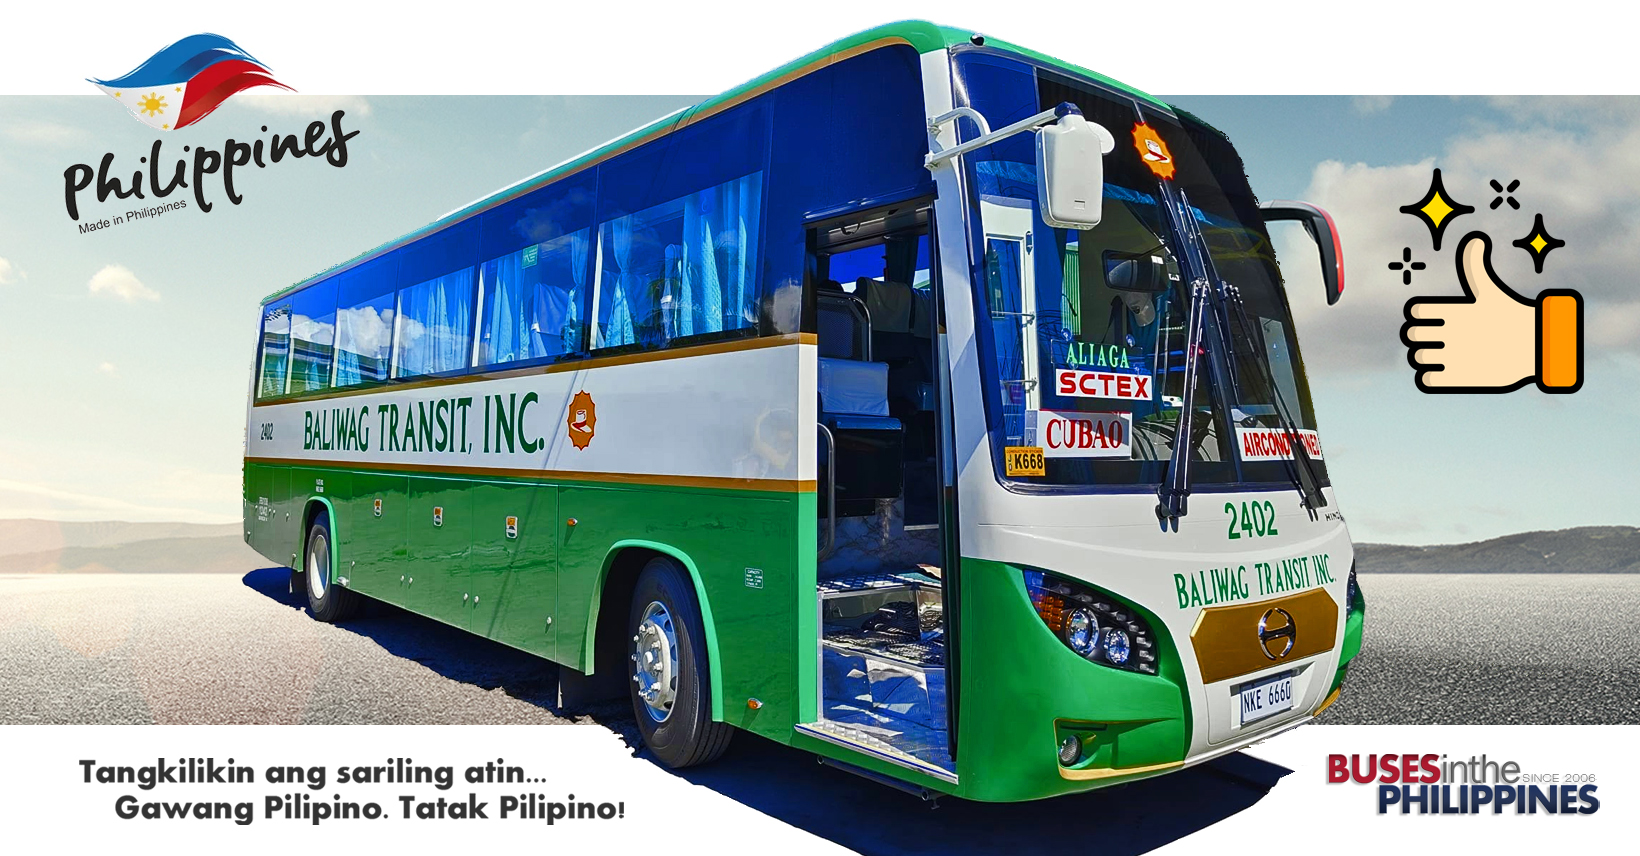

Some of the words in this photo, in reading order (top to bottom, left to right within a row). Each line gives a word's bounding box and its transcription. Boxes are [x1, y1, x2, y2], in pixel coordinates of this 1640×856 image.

[1066, 342, 1130, 369] ALIAGA
[1060, 372, 1149, 398] SCTEX
[260, 423, 274, 441] 2402
[303, 405, 369, 452] BALIWAG
[377, 397, 473, 455] TRANSIT,
[483, 391, 545, 454] INC.
[1046, 418, 1123, 450] CUBAO
[1014, 453, 1044, 470] K668
[1224, 500, 1279, 540] 2402
[1174, 565, 1249, 609] BALIWAG
[1312, 553, 1337, 587] INC.
[1243, 689, 1263, 714] NKE
[1268, 680, 1291, 706] 6660
